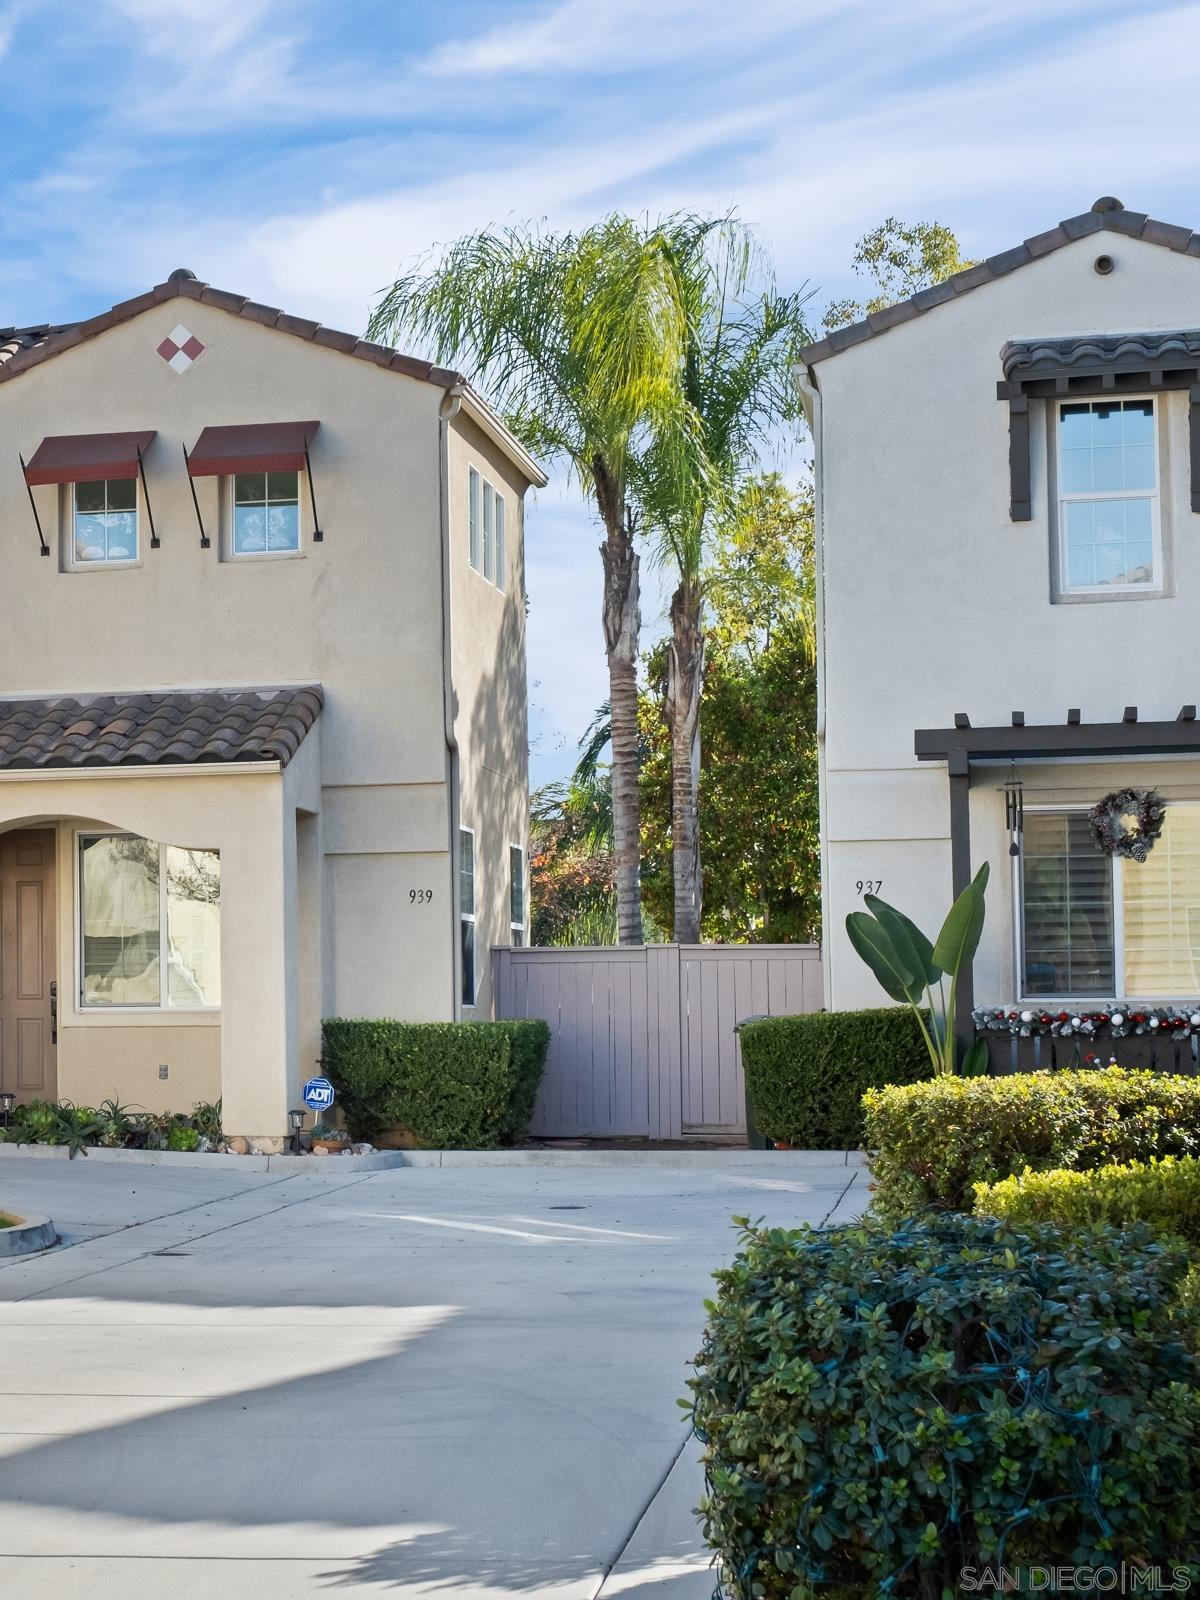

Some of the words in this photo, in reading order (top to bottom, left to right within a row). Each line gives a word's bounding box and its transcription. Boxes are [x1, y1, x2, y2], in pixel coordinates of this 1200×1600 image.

[856, 881, 882, 895] 937
[409, 889, 433, 904] 939
[307, 1088, 330, 1102] ADT
